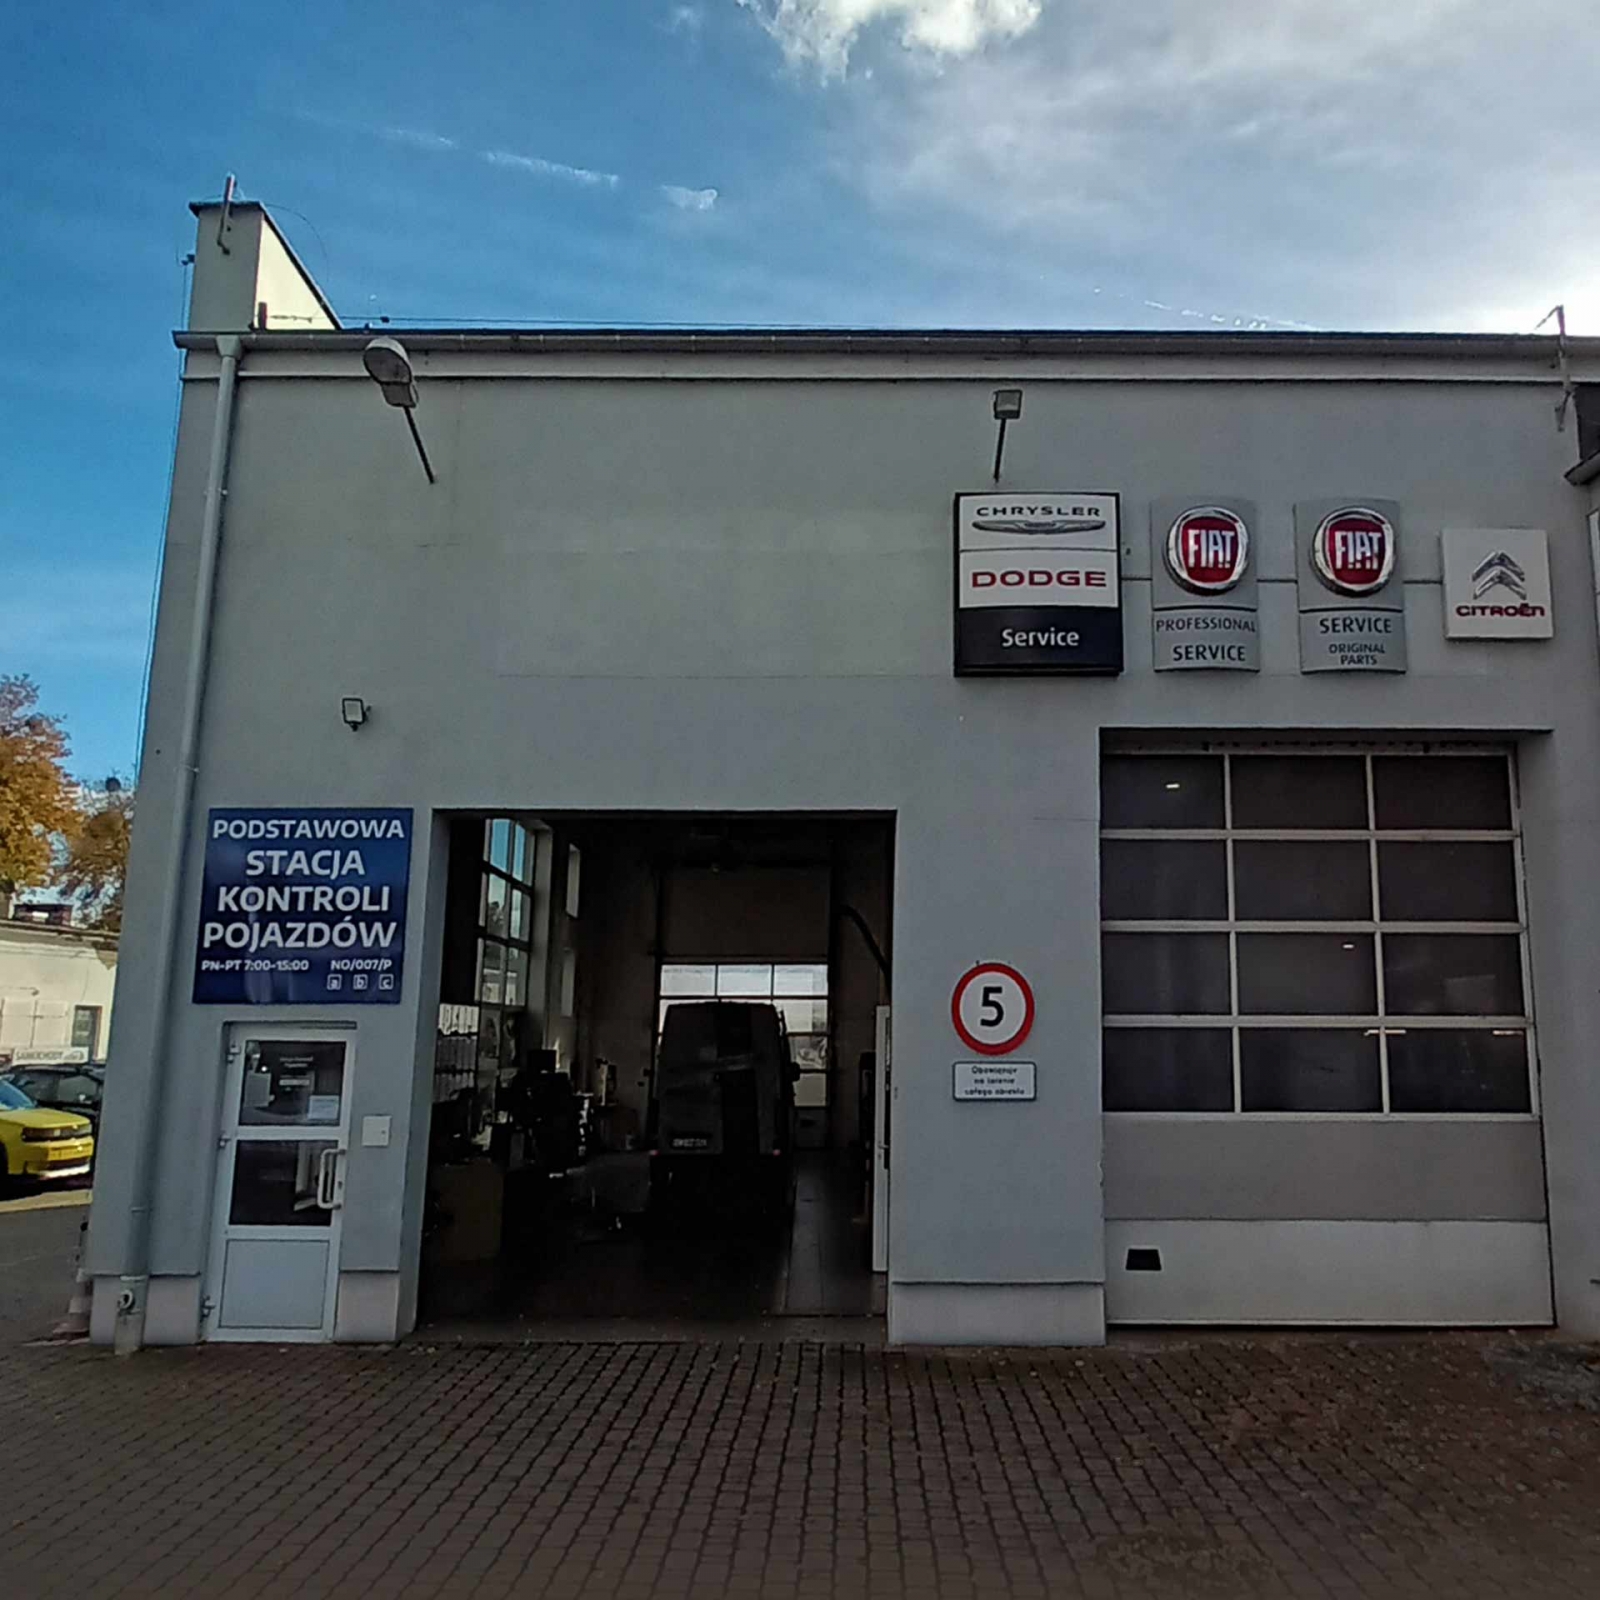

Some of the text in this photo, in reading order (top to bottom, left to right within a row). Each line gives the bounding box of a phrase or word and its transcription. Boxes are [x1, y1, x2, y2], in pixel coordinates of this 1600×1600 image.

[976, 506, 1100, 517] CHRYSLER
[1187, 529, 1236, 569] FIAT
[1333, 530, 1383, 571] FIAT
[972, 570, 1107, 588] DODGE
[1155, 617, 1256, 633] PROFESSIONAL
[1319, 616, 1392, 634] SERVICE
[1001, 627, 1080, 648] Service
[1172, 644, 1246, 662] SERVICE
[1328, 643, 1386, 655] ORIGINAL
[1339, 654, 1378, 667] PARTS
[212, 819, 405, 839] PODSTAWOWA
[246, 849, 366, 880] STACJA
[217, 885, 391, 912] KONTROLI
[203, 915, 398, 953] POJAZDÓW
[201, 959, 242, 971] PN-PT
[980, 986, 1004, 1027] 5
